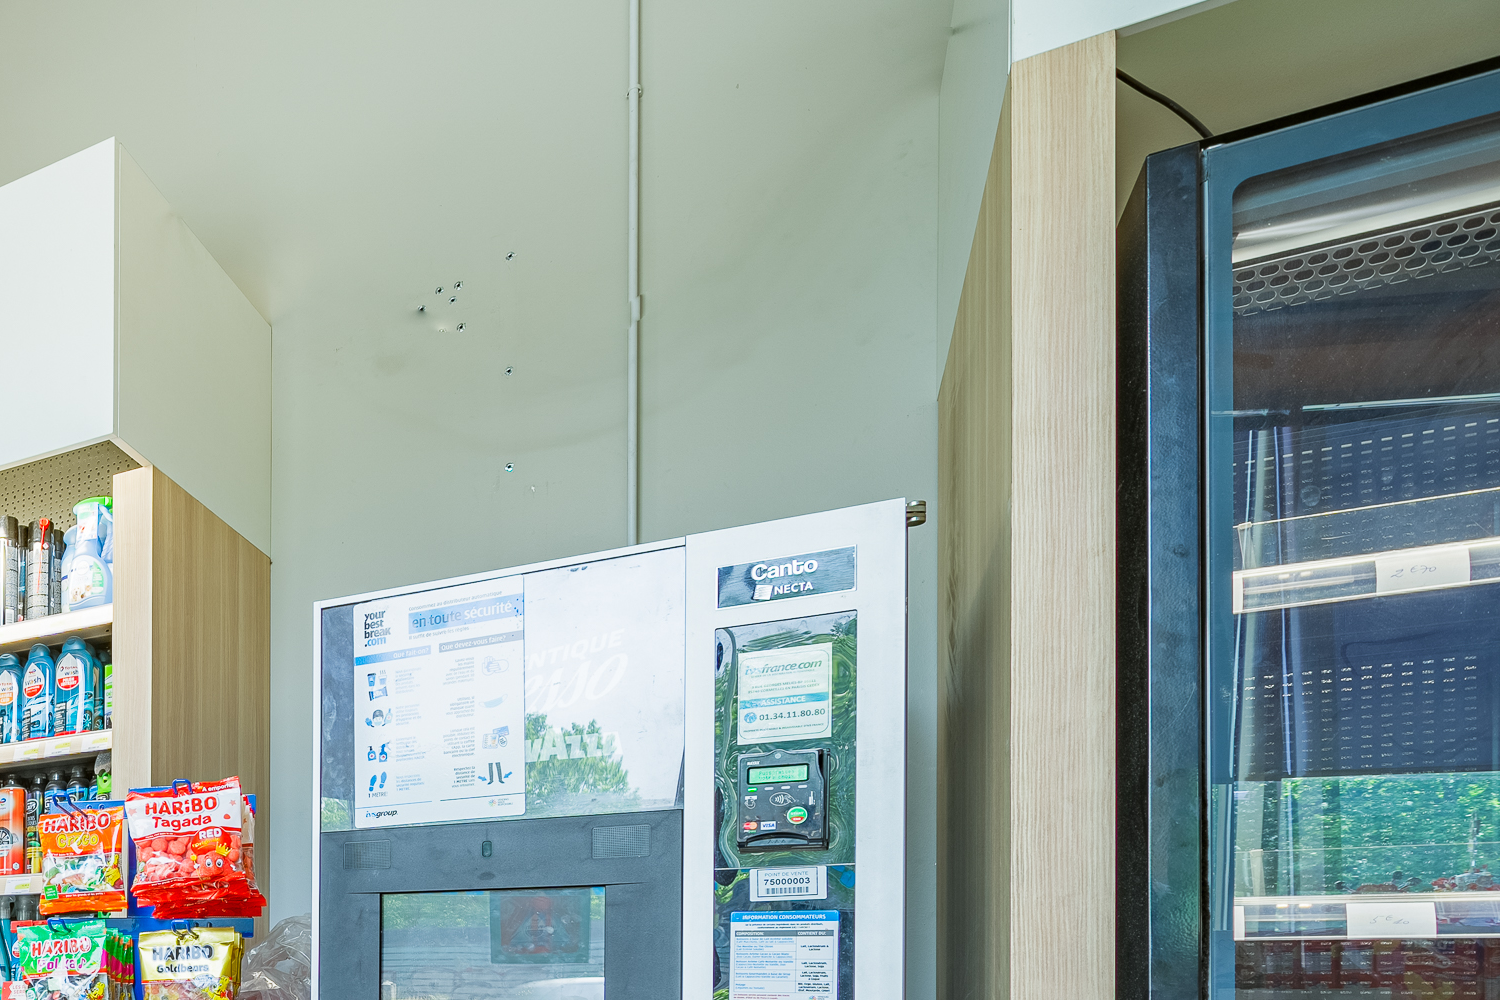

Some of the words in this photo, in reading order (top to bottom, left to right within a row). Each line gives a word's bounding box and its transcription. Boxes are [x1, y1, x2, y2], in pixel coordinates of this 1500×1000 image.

[752, 559, 818, 581] Canto
[774, 581, 813, 595] NECTA
[364, 610, 385, 621] your
[412, 617, 426, 628] en
[429, 611, 462, 625] toute
[464, 601, 512, 620] sécurité
[364, 618, 384, 630] best
[364, 627, 391, 639] break
[364, 636, 386, 647] .com
[442, 643, 454, 651] Que
[455, 638, 488, 649] devez-vous
[489, 635, 506, 643] faire?
[393, 650, 404, 659] Que
[405, 647, 429, 657] fait-on?
[745, 660, 822, 676] ivsfrance.com
[25, 676, 41, 685] wash
[761, 696, 806, 706] ASSISTANCE
[759, 708, 825, 721] 01.34.11.80.80
[208, 783, 234, 791] emporter
[145, 797, 217, 815] HARIBO
[43, 813, 110, 832] HARIBO
[152, 815, 211, 831] Tagada
[199, 828, 222, 839] RED
[57, 833, 98, 848] Croco
[764, 878, 810, 886] 75000003
[31, 937, 91, 958] HARIBO
[152, 945, 213, 961] HARIBO
[157, 963, 209, 973] Goldbears
